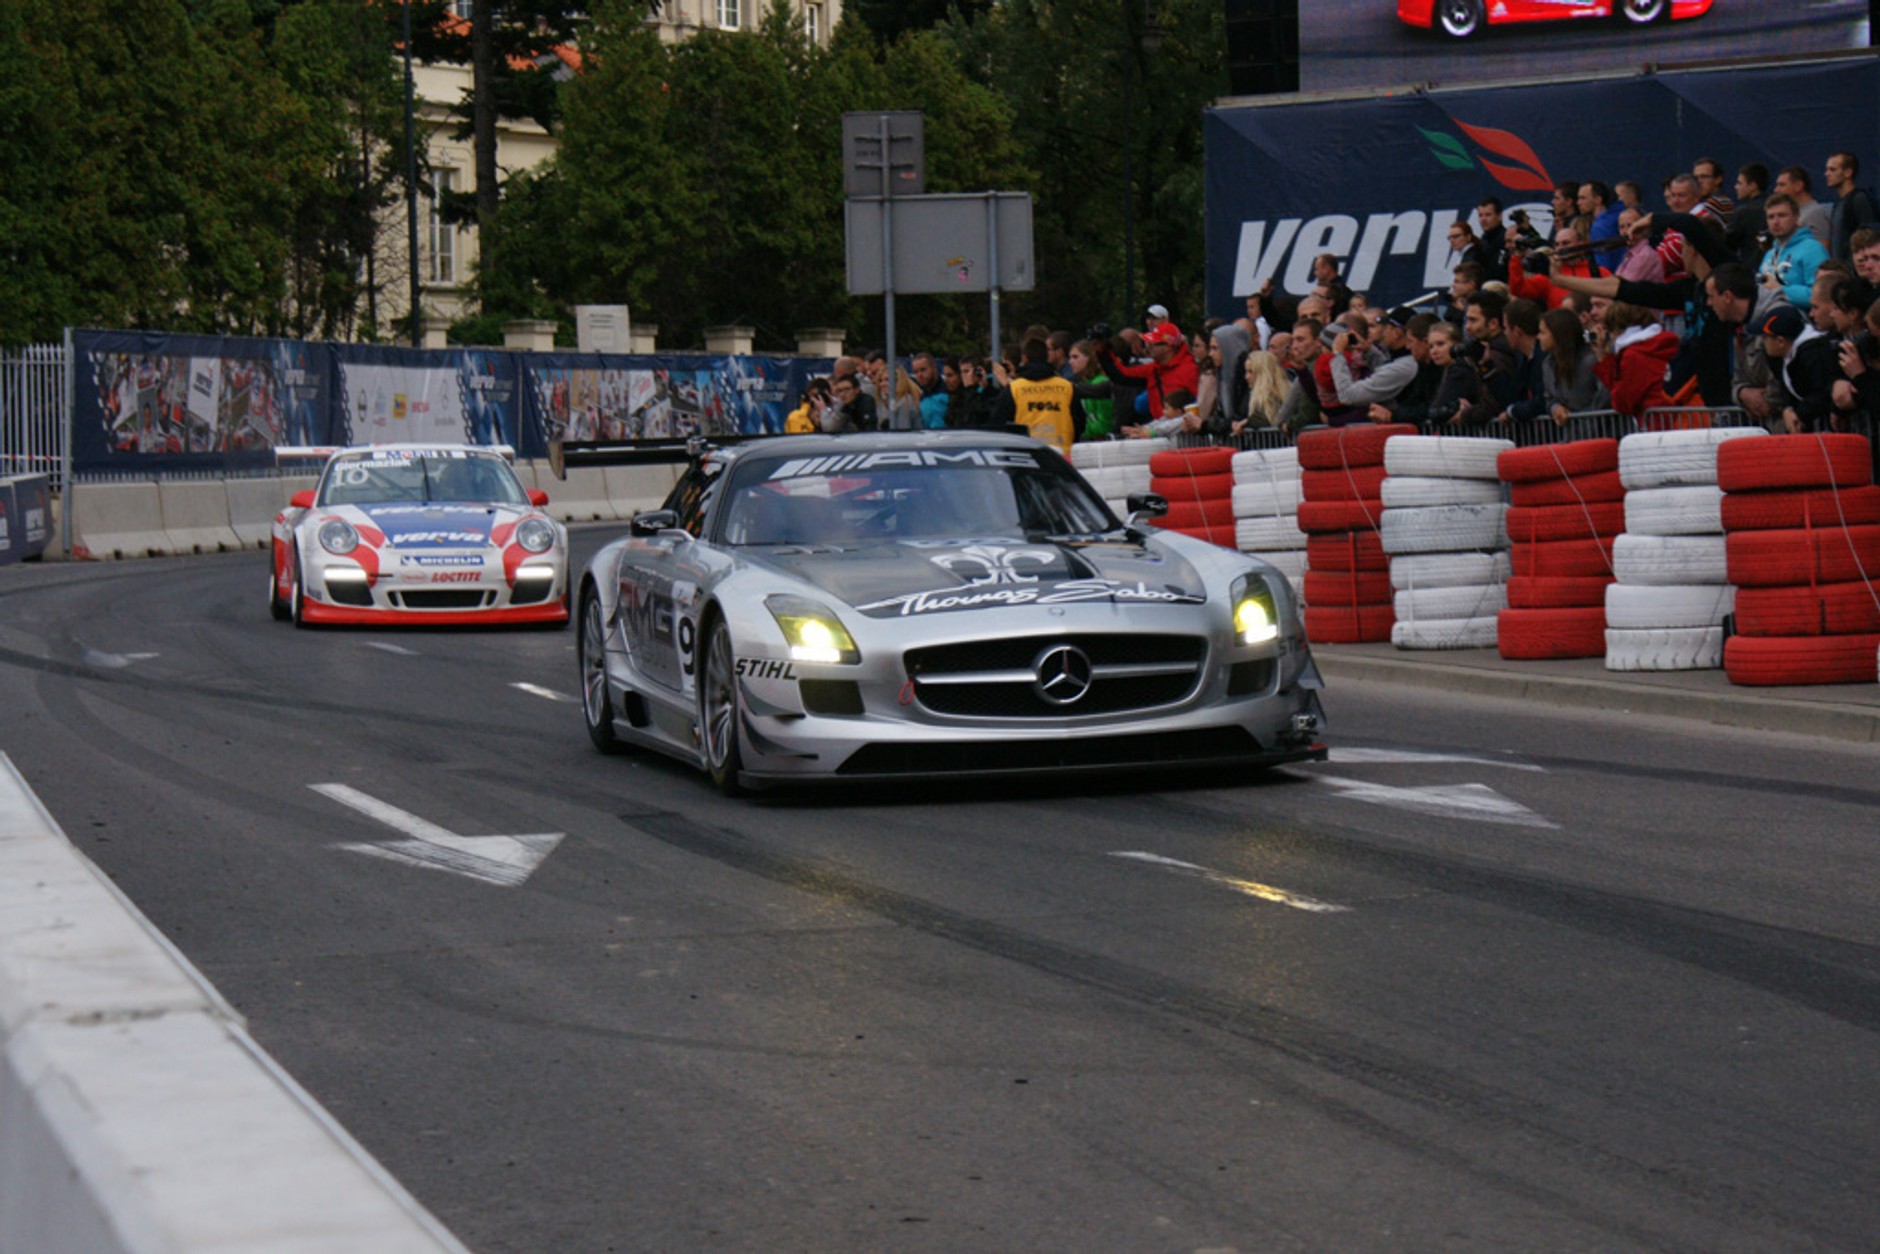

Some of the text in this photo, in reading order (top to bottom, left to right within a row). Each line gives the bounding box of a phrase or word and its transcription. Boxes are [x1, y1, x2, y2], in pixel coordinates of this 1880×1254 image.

[857, 450, 1040, 469] AMG
[334, 467, 369, 486] 10
[393, 531, 485, 543] verva
[420, 557, 481, 566] MICHELIN
[431, 571, 483, 583] LOCTITE
[855, 578, 1206, 616] Thomas Sabo
[679, 616, 696, 676] 9
[735, 658, 797, 681] STIHL
